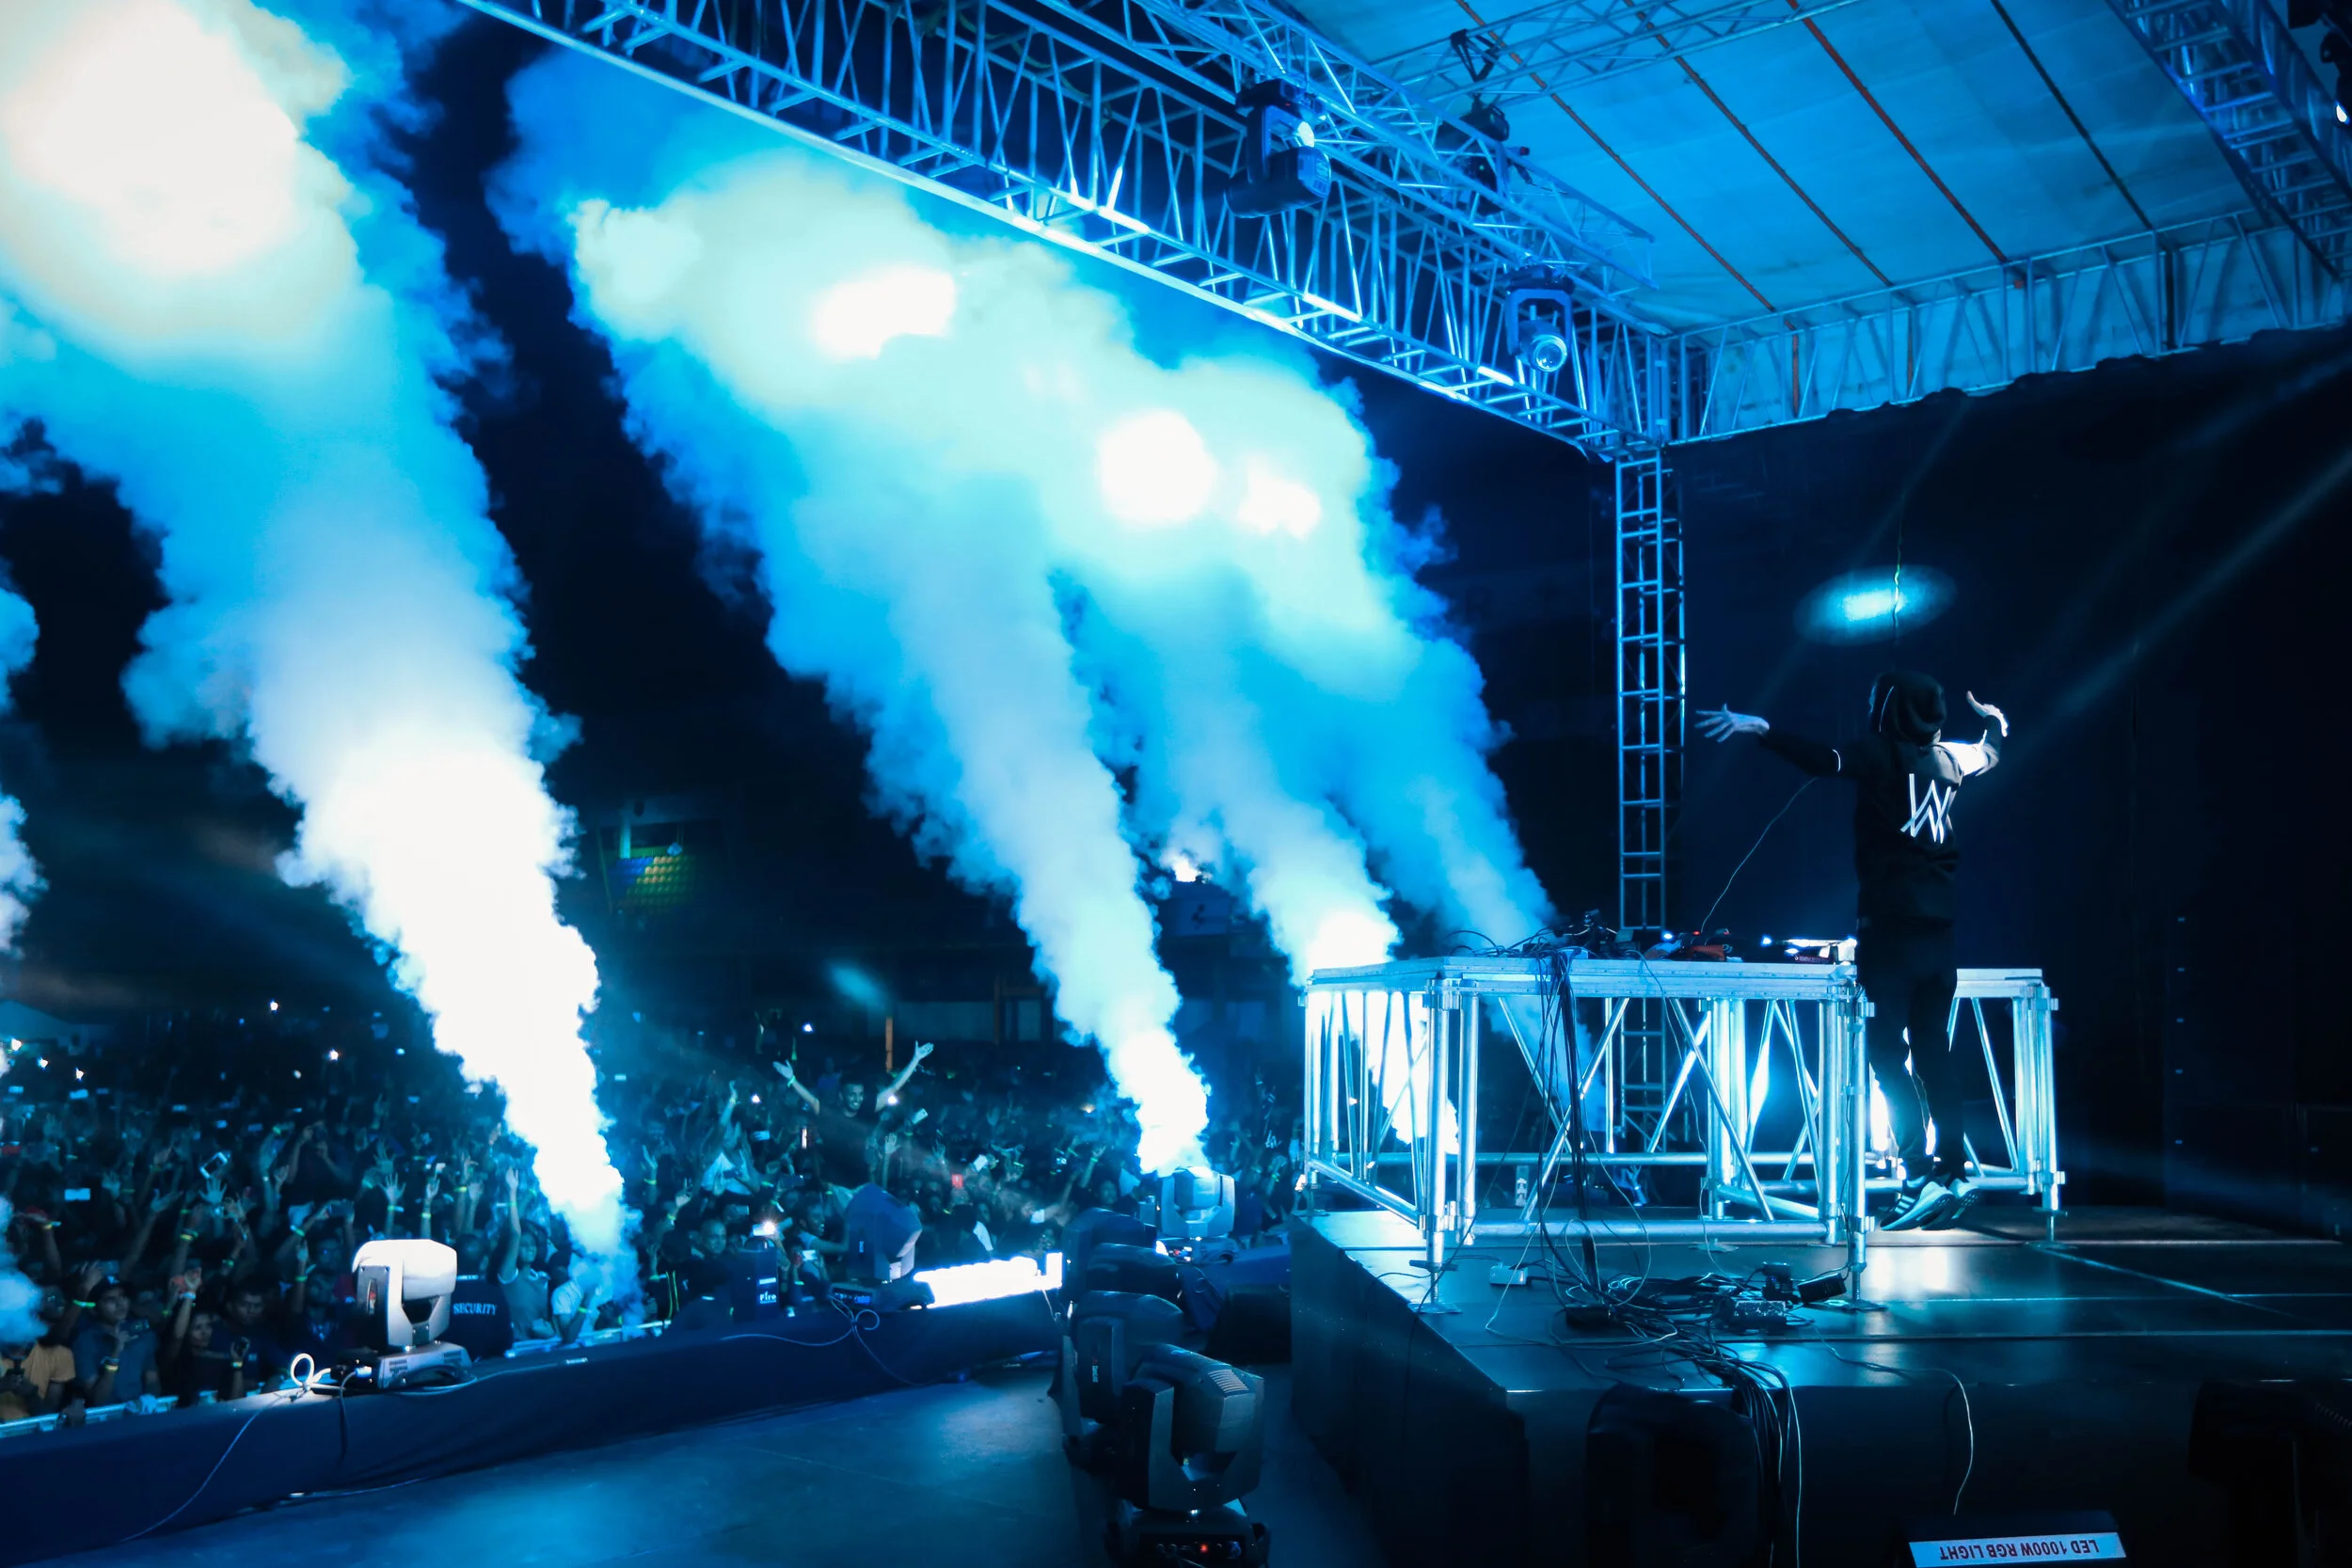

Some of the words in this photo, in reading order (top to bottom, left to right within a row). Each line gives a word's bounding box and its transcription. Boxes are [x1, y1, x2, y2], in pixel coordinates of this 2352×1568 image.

[453, 1302, 497, 1316] SECURITY
[1939, 1544, 1983, 1560] LIGHT
[1986, 1543, 2018, 1559] RGB
[2020, 1541, 2068, 1557] 1000W
[2070, 1539, 2100, 1554] LED
